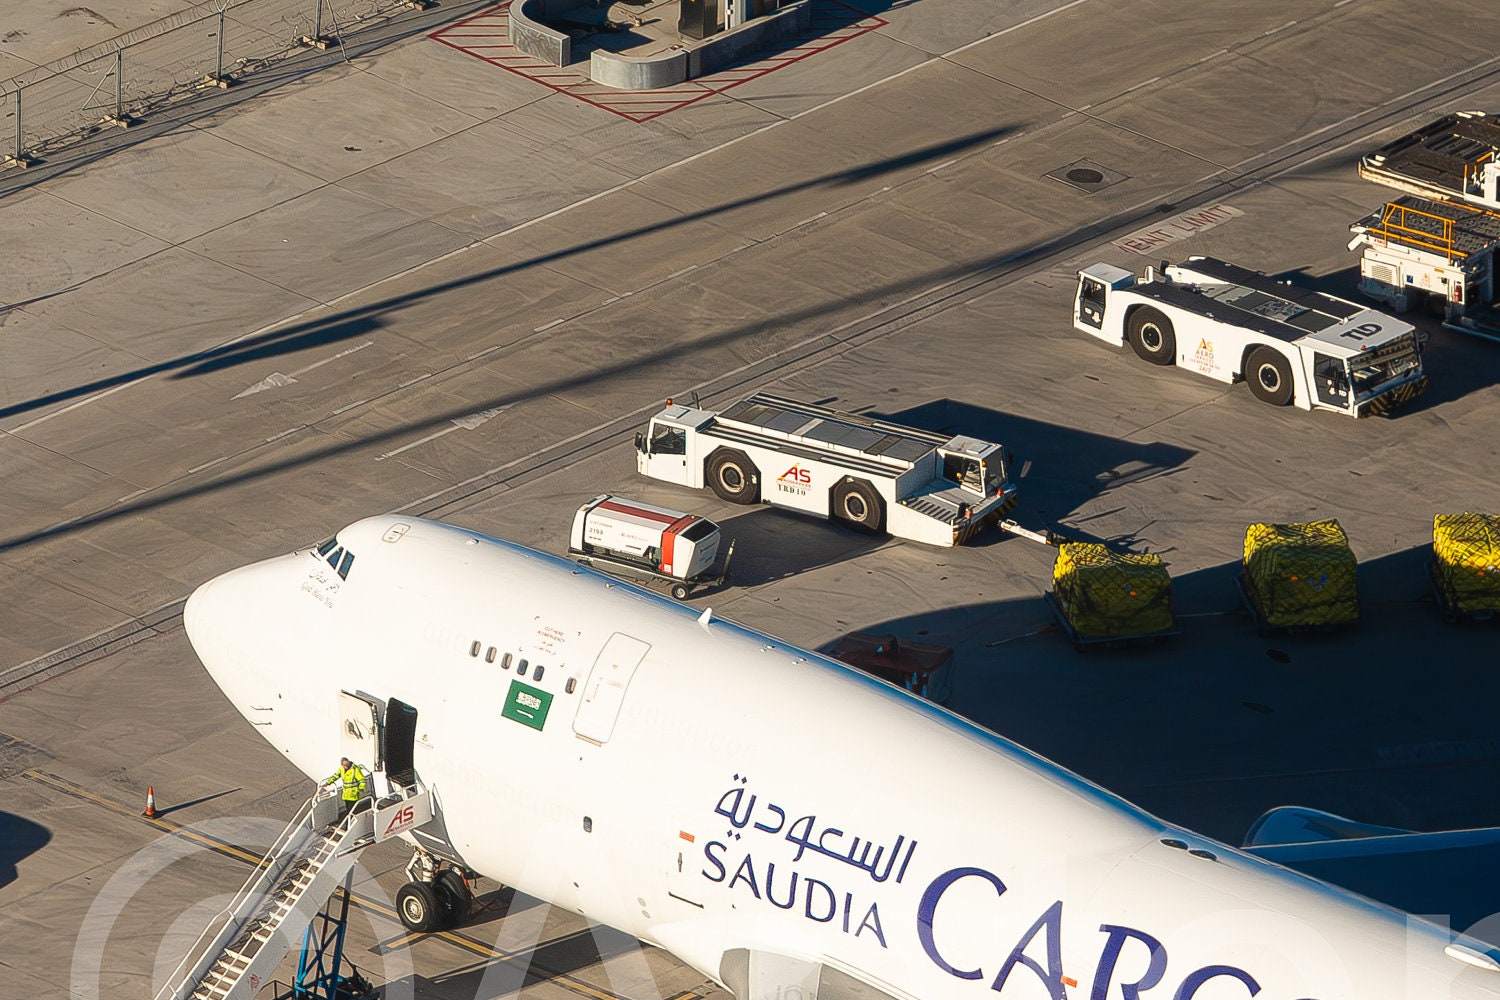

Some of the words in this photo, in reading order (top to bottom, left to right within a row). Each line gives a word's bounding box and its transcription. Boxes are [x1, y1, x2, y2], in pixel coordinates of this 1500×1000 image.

[1169, 205, 1232, 232] LIMIT
[1198, 337, 1214, 353] AS
[1340, 323, 1383, 341] TLD
[777, 462, 811, 483] AS
[383, 803, 414, 836] AS
[714, 773, 917, 884] السعودية
[702, 841, 888, 949] SAUDIA
